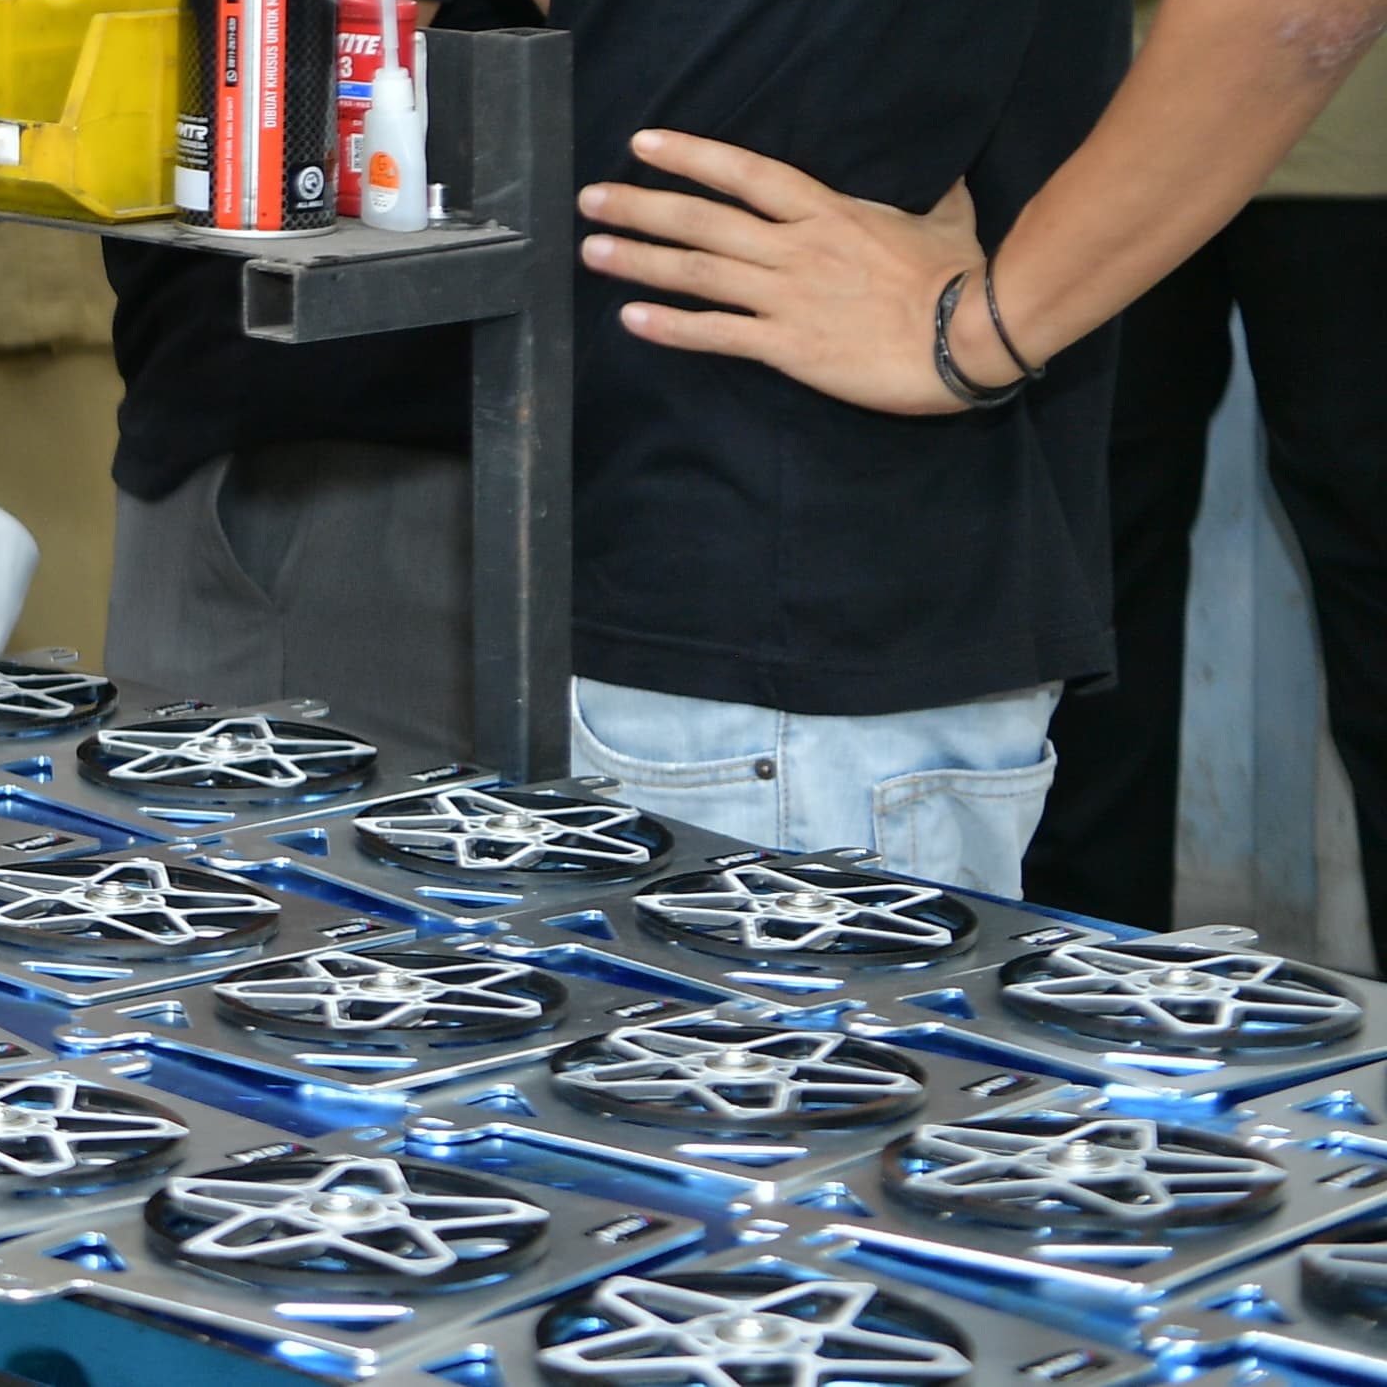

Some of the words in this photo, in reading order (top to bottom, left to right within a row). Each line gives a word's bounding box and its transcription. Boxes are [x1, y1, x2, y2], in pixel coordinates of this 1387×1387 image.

[266, 9, 280, 43] UNTUK
[338, 32, 383, 55] TITE
[265, 45, 279, 88] KHUSUS
[339, 55, 354, 79] 3
[263, 90, 278, 128] DIBUAT
